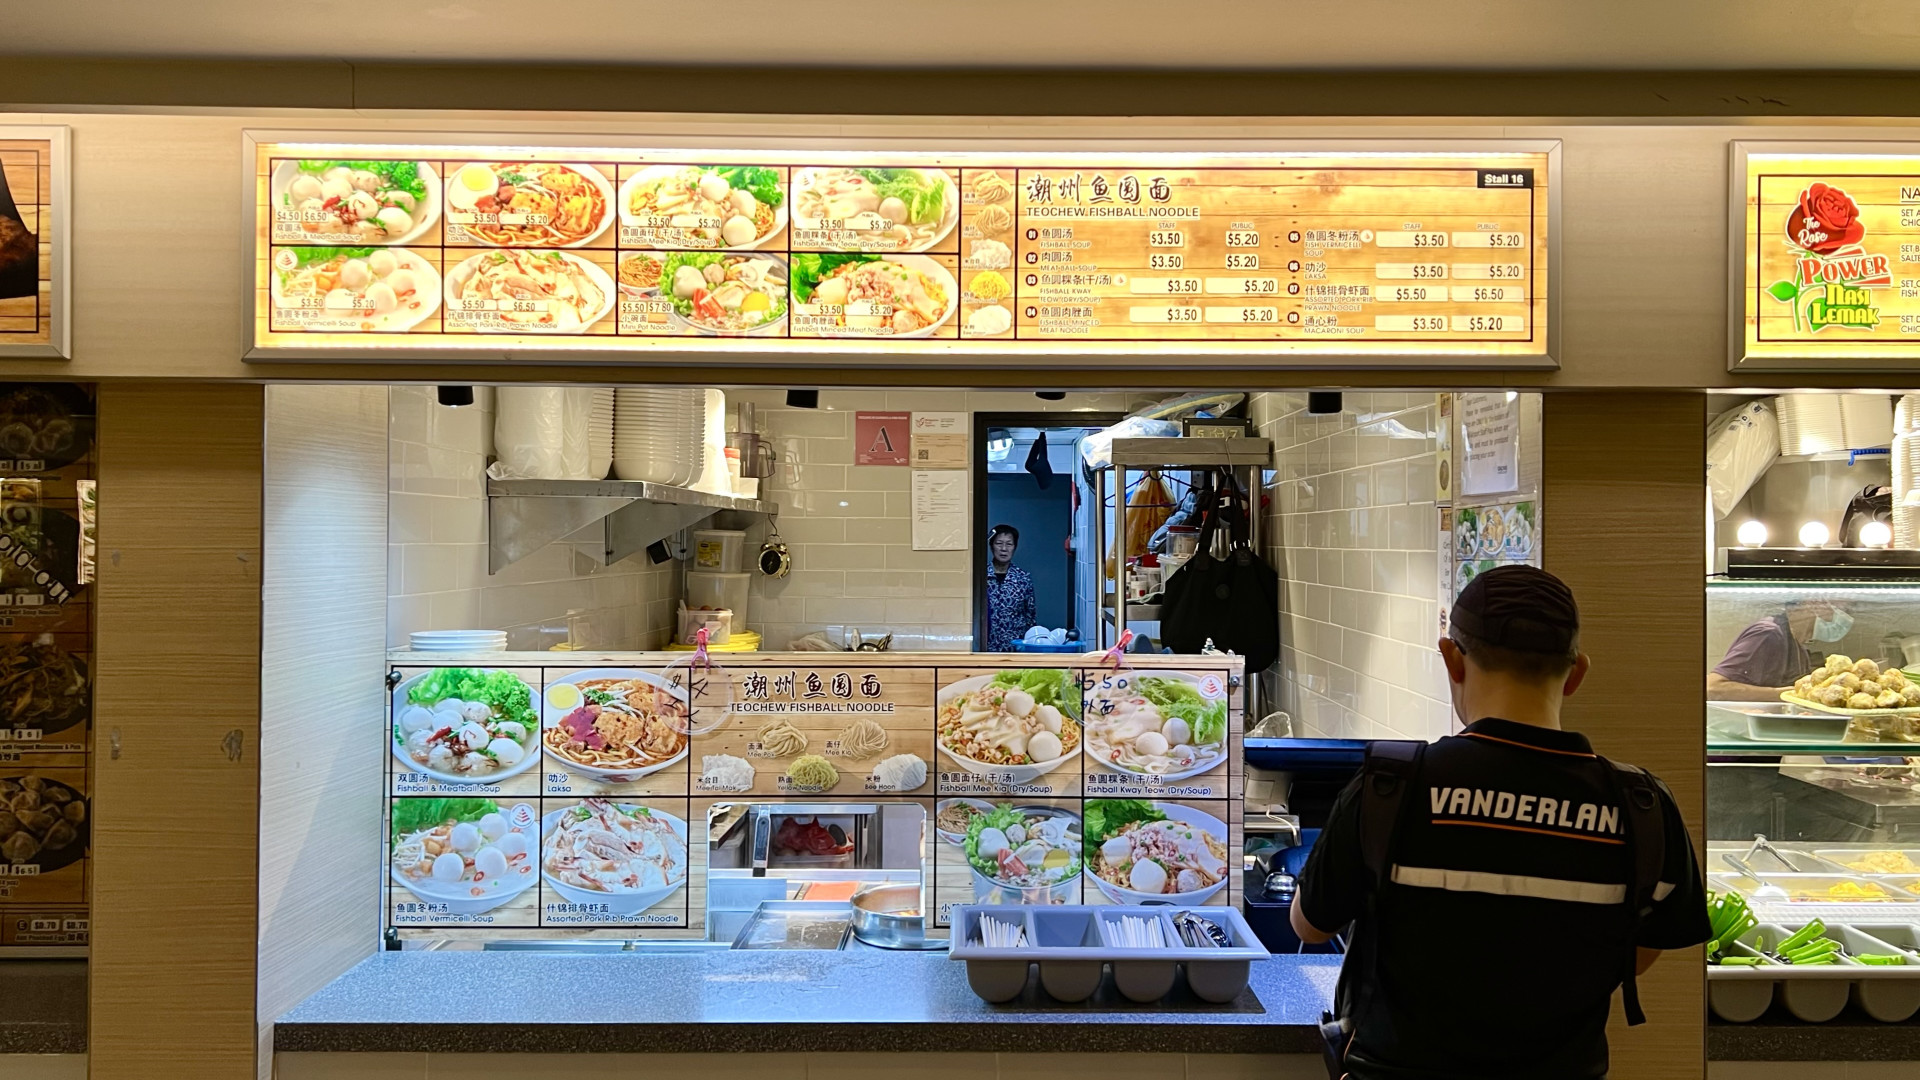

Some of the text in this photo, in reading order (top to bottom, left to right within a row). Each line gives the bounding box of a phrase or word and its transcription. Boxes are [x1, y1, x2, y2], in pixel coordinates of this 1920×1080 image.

[1484, 174, 1524, 184] Stall 16
[277, 211, 327, 221] $4.50 $6.50
[1026, 207, 1199, 217] TEOCHEW FISHBALL NOODLE
[1901, 209, 1914, 217] SET
[474, 214, 548, 225] $3.50 $5.20
[647, 217, 721, 228] $3.50 $5.20
[820, 219, 892, 230] $3.50 $5.20
[1802, 216, 1820, 231] The
[1042, 228, 1073, 239] 鱼圆汤
[1306, 230, 1359, 241] 鱼圆冬粉汤
[1797, 229, 1828, 247] Rose
[1151, 232, 1259, 246] $3.50 $5.20
[1414, 233, 1520, 248] $3.50 $5.20
[1901, 244, 1913, 253] SET
[1041, 252, 1073, 262] 肉圆汤
[1151, 255, 1257, 269] $3.50 $5.20
[1413, 265, 1520, 280] $3.50 $5.20
[1168, 280, 1275, 294] $3.50 $5.20
[1901, 279, 1914, 288] SET
[1305, 285, 1370, 296] 什锦排骨虾面
[1396, 287, 1504, 302] $5.50 $6.50
[1901, 289, 1918, 297] FISH
[301, 298, 324, 308] $3.50
[462, 300, 536, 312] $5.50 $6.50
[622, 302, 671, 313] $5.50 $7.80
[819, 305, 892, 315] $3.50 $5.20
[1167, 308, 1273, 323] $3.50 $5.20
[1901, 315, 1914, 323] SET
[1304, 316, 1338, 327] 通心粉
[1413, 317, 1503, 332] $3.50 $5.20
[869, 426, 896, 452] A
[743, 671, 883, 699] 潮州鱼圆面
[730, 702, 894, 712] TEOCHEW FISHBALL NOODLE
[398, 773, 429, 783] 双圆汤
[548, 774, 568, 783] 叻沙
[941, 773, 1016, 783] 鱼圆面仔 (干/汤)
[1088, 775, 1164, 785] 鱼圆粿条 (干/汤)
[439, 785, 477, 793] Meatball
[479, 785, 501, 794] Soup
[547, 785, 572, 793] Laksa
[940, 785, 1053, 794] Fishball Mee Kia (Dry/Soup)
[1087, 786, 1212, 796] Fishball Kway Teow (Dry/Soup)
[1430, 786, 1625, 835] VANDERLAN
[396, 903, 448, 913] 鱼圆冬粉汤
[547, 903, 609, 913] 什锦排骨虾面
[429, 915, 471, 923] Vermicelli
[472, 915, 494, 924] Soup
[546, 915, 583, 923] Assorted
[584, 915, 602, 923] Pork
[620, 915, 646, 923] Prawn
[647, 915, 679, 923] Noodle
